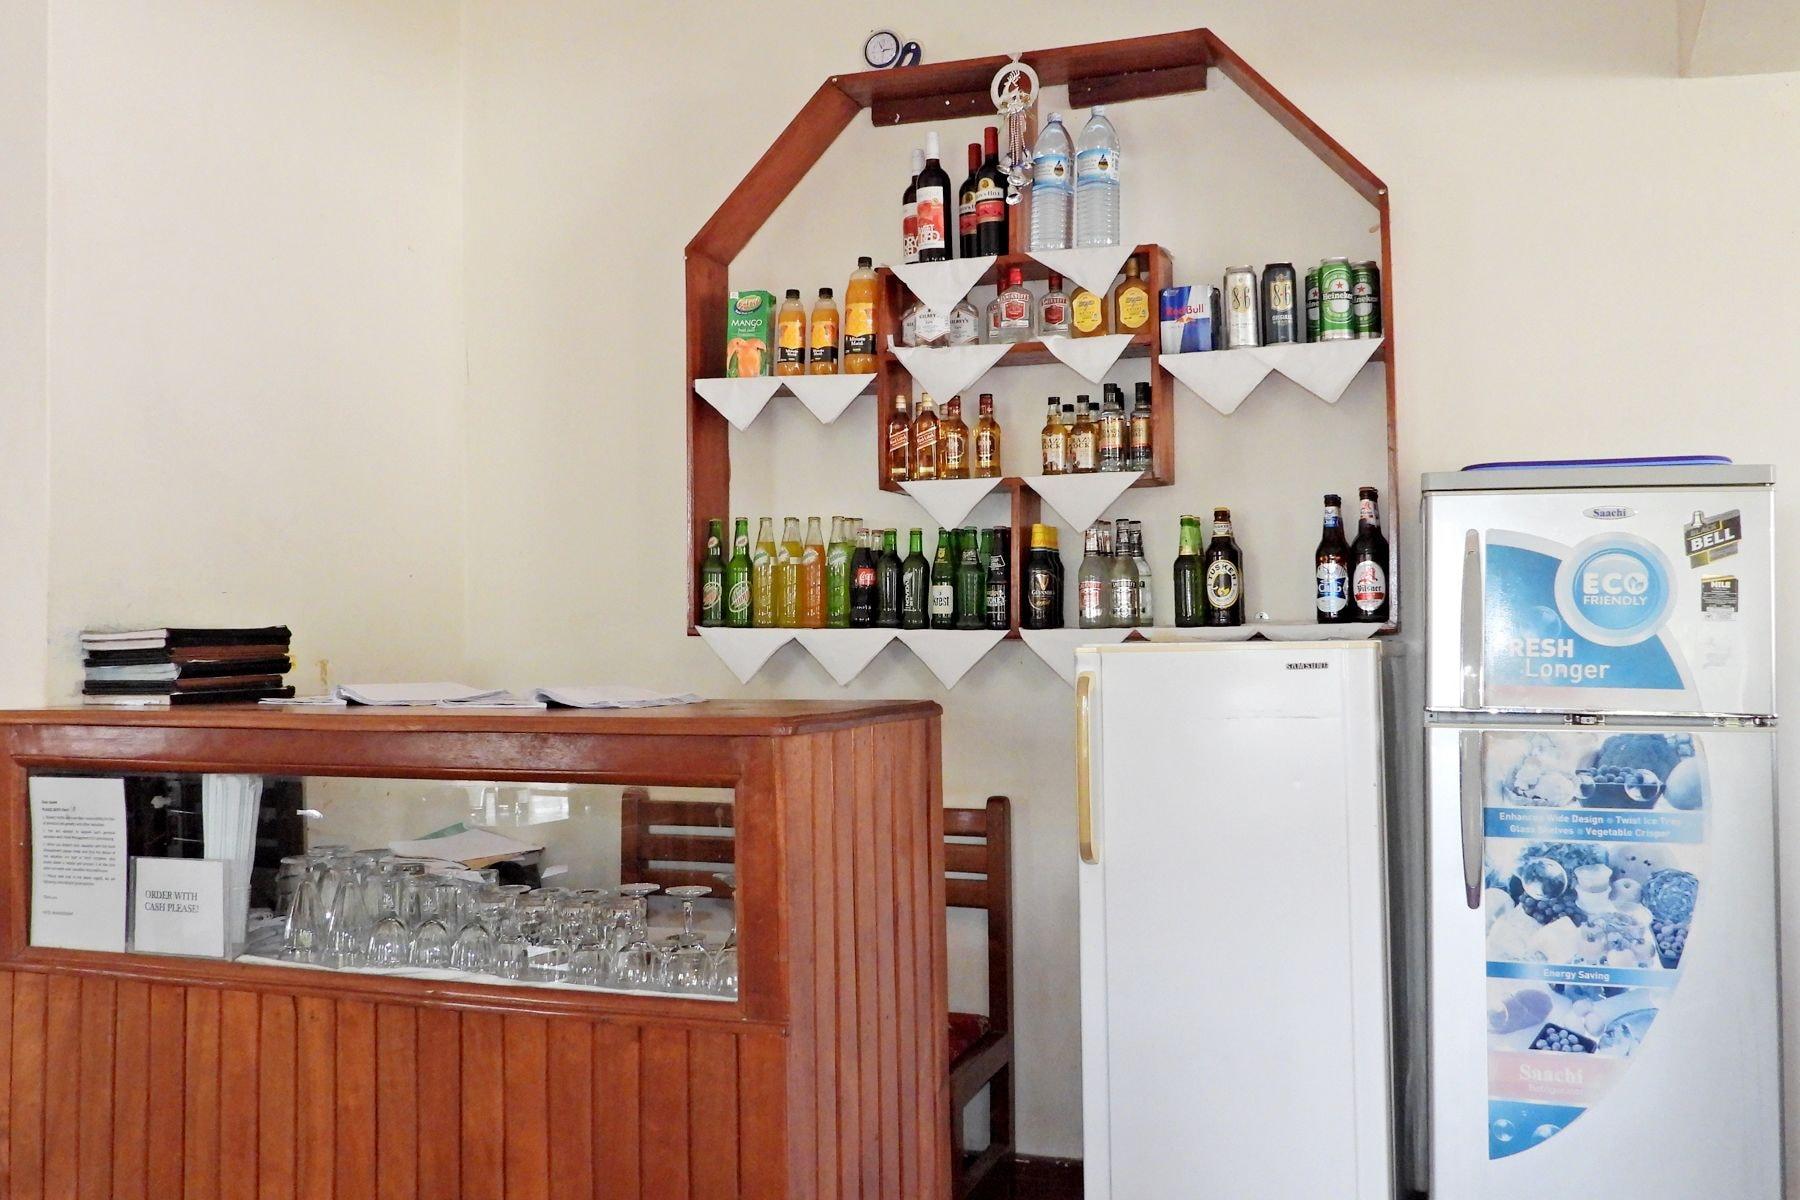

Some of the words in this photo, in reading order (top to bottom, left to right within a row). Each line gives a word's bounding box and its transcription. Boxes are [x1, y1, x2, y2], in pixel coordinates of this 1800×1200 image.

[1322, 292, 1353, 300] Heineke
[1187, 303, 1204, 314] Bull
[731, 319, 763, 329] MANGO
[1593, 509, 1626, 517] Saachi
[1691, 527, 1735, 552] BELL
[1207, 564, 1237, 580] TUSKER
[1357, 585, 1382, 593] Pilsner
[1583, 572, 1648, 595] ECO
[1583, 595, 1648, 606] FRIENDLY
[1504, 638, 1574, 658] RESH
[1526, 658, 1611, 684] Longer
[1571, 815, 1604, 825] Design
[1616, 815, 1641, 825] Twist
[1585, 827, 1633, 838] Vegetable
[144, 890, 172, 900] ORDER
[174, 891, 198, 901] WITH
[144, 902, 166, 912] CASH
[167, 903, 200, 913] PLEASE!
[1543, 969, 1576, 981] Energy
[1578, 970, 1611, 982] Saving
[1519, 1063, 1584, 1085] Saachi
